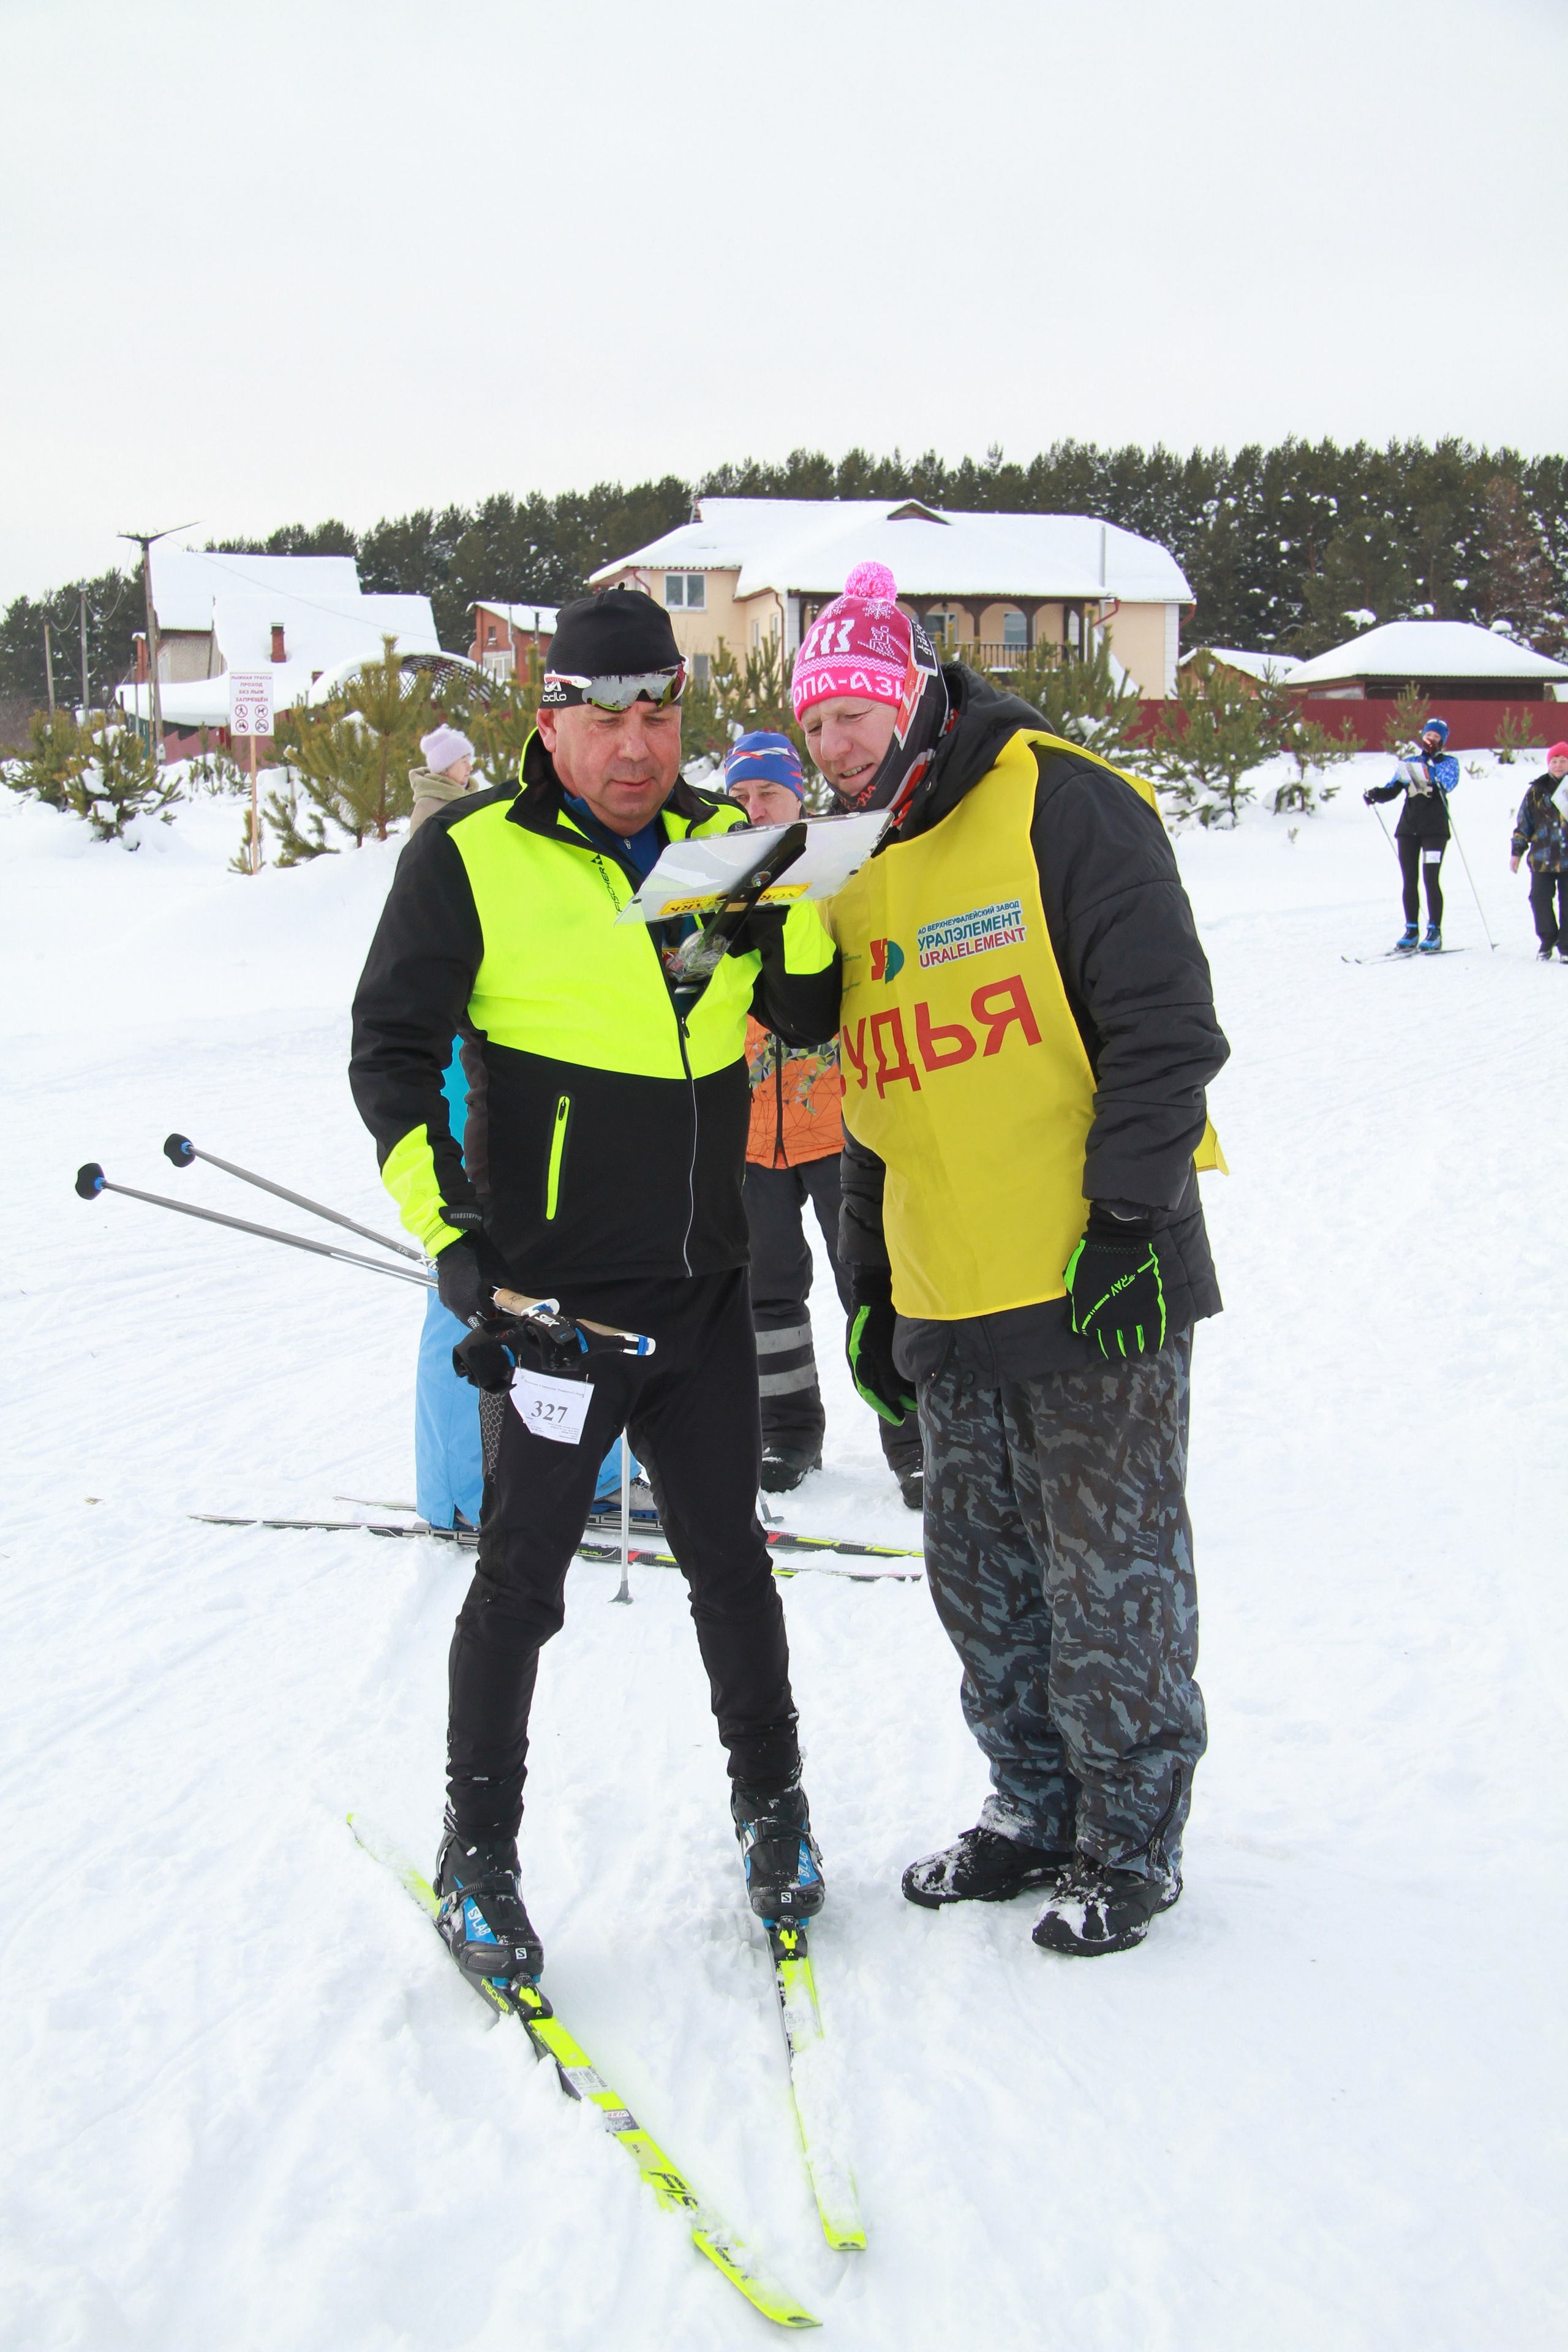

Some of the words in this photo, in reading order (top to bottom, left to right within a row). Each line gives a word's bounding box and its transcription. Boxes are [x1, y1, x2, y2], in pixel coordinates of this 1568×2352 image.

[542, 692, 567, 702] odlo
[599, 867, 623, 913] FISCHER
[918, 910, 1022, 951] УРАЛЭЛЕМЕНТ
[927, 906, 995, 932] ВЕРХНЕУФАЛЕЙСКИЙ
[996, 900, 1020, 913] ЗАВОД
[919, 927, 1025, 968] URALELEMENT
[840, 974, 1042, 1099] УДЬЯ
[534, 1314, 560, 1327] SWIX
[530, 1400, 568, 1423] 327
[481, 1978, 510, 2013] FISCHER
